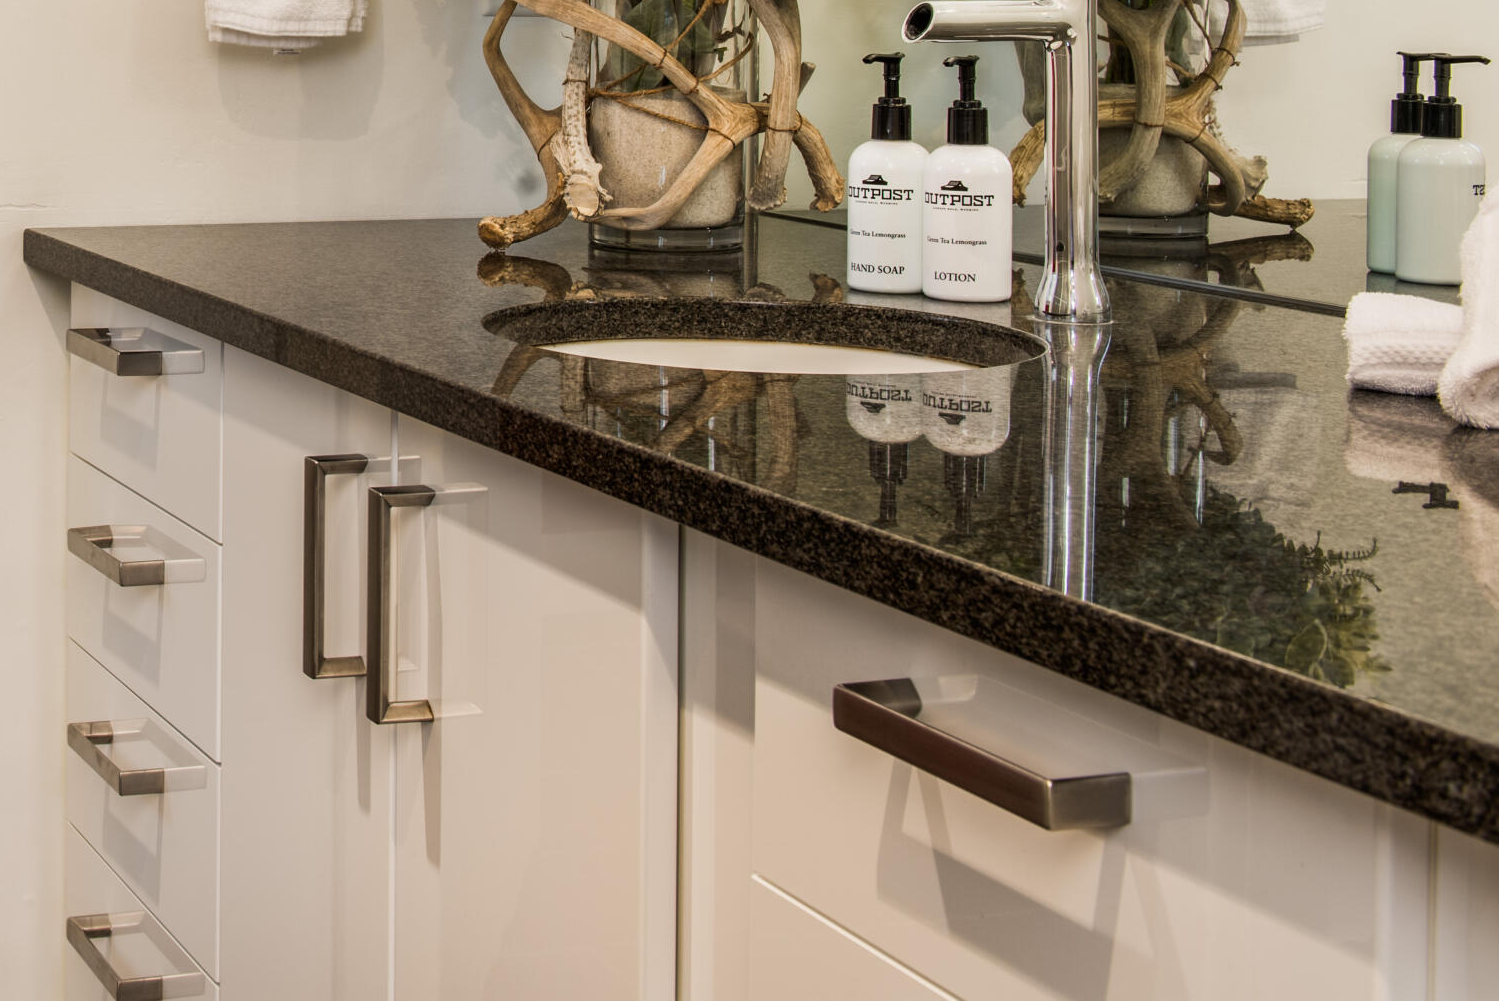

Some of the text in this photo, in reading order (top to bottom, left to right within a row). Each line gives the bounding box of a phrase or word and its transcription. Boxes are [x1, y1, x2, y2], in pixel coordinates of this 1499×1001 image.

[924, 191, 995, 207] OUTPOST
[871, 231, 907, 239] Lemongrass
[951, 238, 987, 246] Lemongrass
[850, 262, 905, 275] HAND SOAP
[934, 271, 976, 282] LOTION
